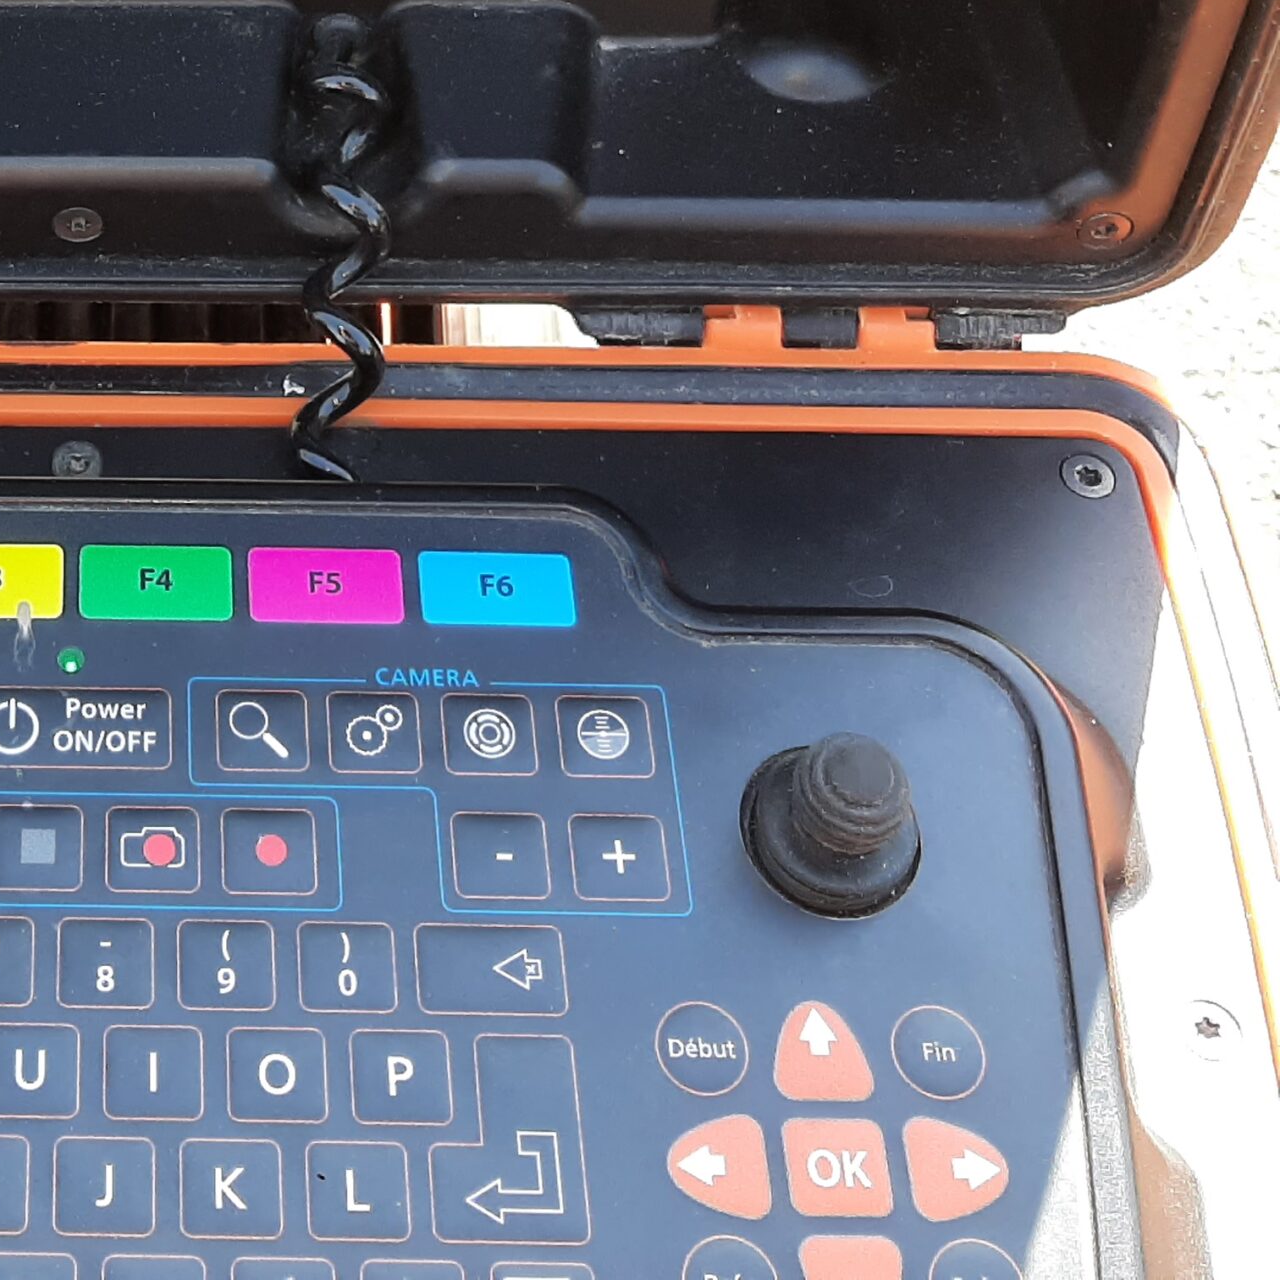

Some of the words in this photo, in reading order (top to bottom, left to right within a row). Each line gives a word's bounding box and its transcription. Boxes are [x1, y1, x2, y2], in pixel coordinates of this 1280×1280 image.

[138, 567, 174, 592] F4
[308, 570, 342, 595] F5
[479, 573, 514, 598] F6
[374, 666, 480, 688] CAMERA
[65, 697, 146, 720] Power
[53, 730, 157, 753] ON/OFF
[96, 965, 115, 992] 8
[217, 967, 236, 994] 9
[338, 968, 358, 997] 0
[667, 1038, 737, 1059] Début
[922, 1041, 956, 1062] Fin
[14, 1048, 46, 1091] U
[149, 1051, 158, 1093] I
[258, 1053, 296, 1095] O
[387, 1055, 414, 1097] P
[807, 1149, 873, 1188] OK
[95, 1164, 113, 1207] J
[214, 1167, 247, 1210] K
[345, 1169, 371, 1212] L
